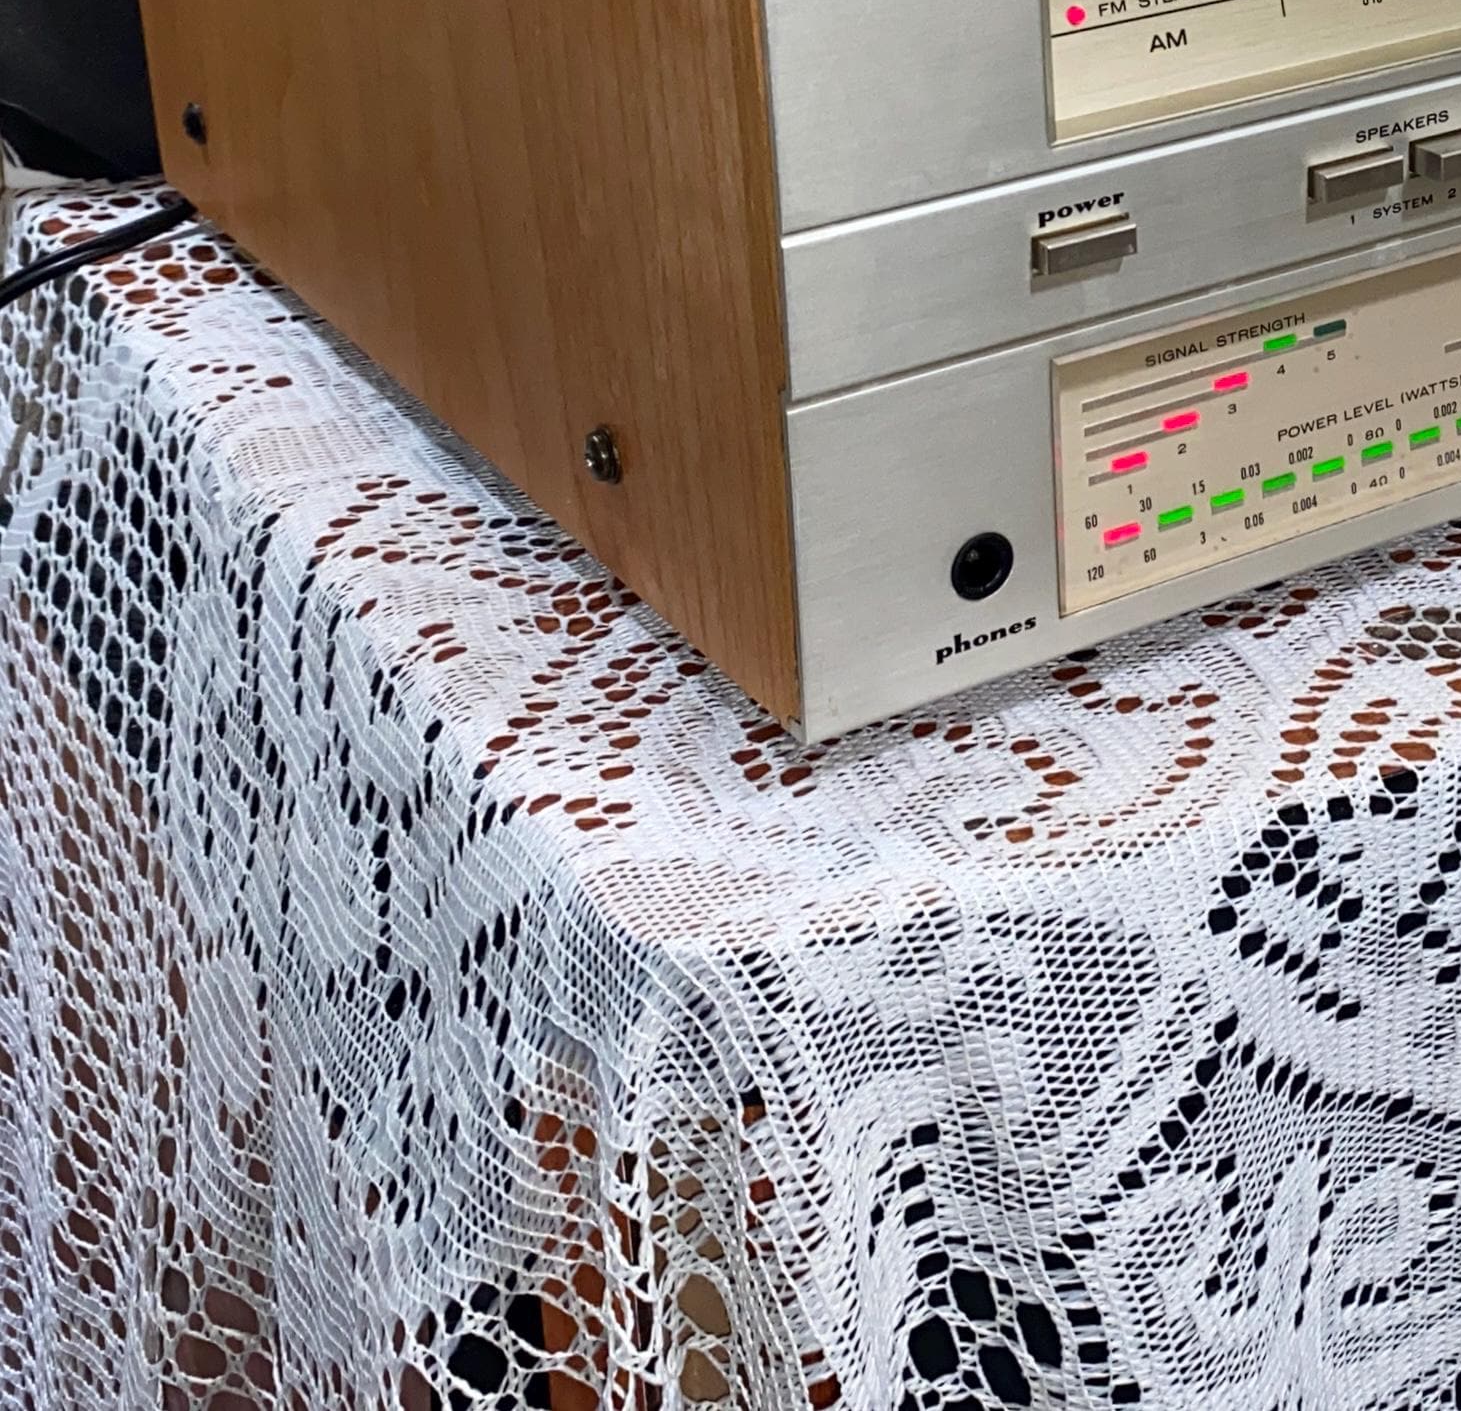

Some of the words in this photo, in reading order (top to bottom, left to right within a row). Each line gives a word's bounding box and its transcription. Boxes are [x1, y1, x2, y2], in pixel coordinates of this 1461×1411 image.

[1149, 28, 1189, 53] AM
[1355, 109, 1450, 144] SPEAKERS
[1037, 191, 1126, 229] power
[1372, 193, 1434, 220] SYSTEM
[1446, 187, 1458, 200] 2
[1144, 341, 1209, 369] SIGNAL
[1215, 312, 1306, 348] STRENGTH
[1325, 348, 1337, 362] 5
[1275, 363, 1287, 376] 4
[1226, 402, 1238, 416] 3
[1277, 412, 1338, 443] POWER
[1343, 397, 1394, 422] LEVEL
[1084, 513, 1099, 530] 60
[1139, 496, 1153, 513] 30
[1240, 462, 1261, 481] 0.03
[1288, 446, 1314, 465] 0.002
[1433, 400, 1458, 420] 0.002
[1176, 442, 1188, 456] 2
[1087, 564, 1105, 583] 120
[1143, 547, 1157, 564] 60
[1199, 530, 1207, 545] 3
[1243, 512, 1265, 531] 0.06
[1292, 494, 1319, 515] 0.004
[1436, 448, 1461, 467] 0.004
[935, 615, 1038, 666] phones
